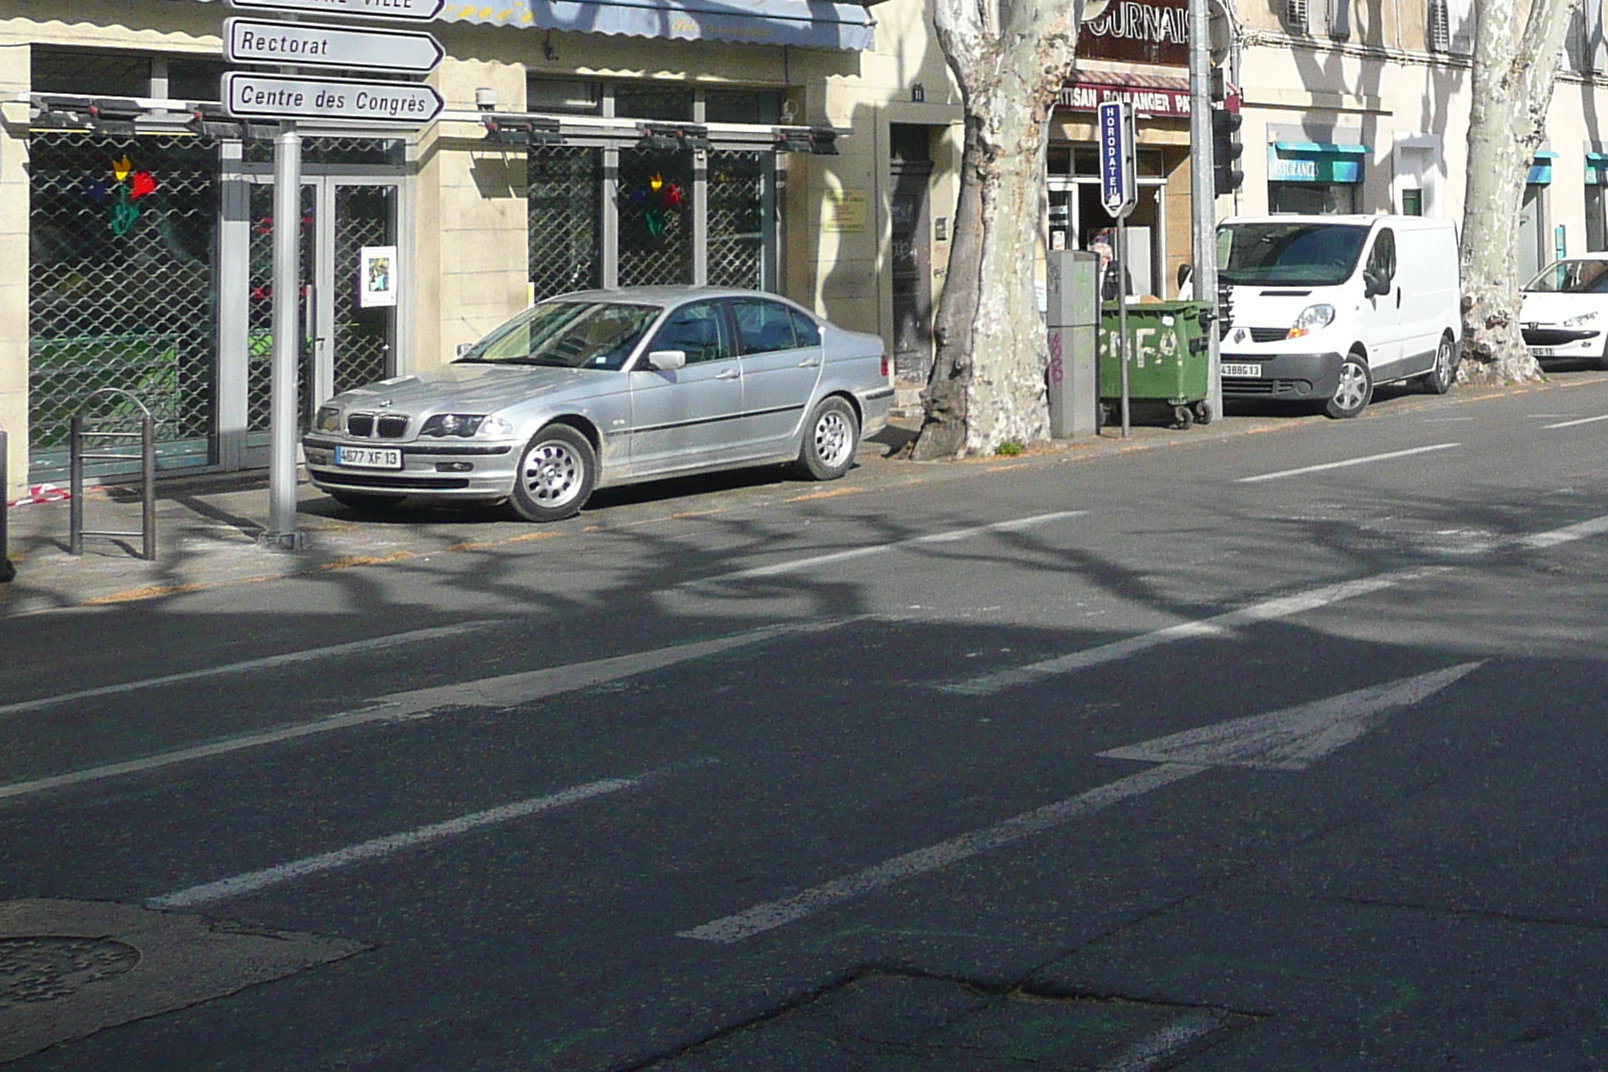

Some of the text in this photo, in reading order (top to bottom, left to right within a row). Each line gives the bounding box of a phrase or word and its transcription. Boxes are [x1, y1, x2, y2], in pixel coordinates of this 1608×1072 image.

[241, 31, 329, 55] Rectorat
[241, 85, 426, 116] Centre des Congrès
[1106, 107, 1118, 196] HORODATEU
[368, 450, 383, 465] XF
[385, 452, 397, 465] 13
